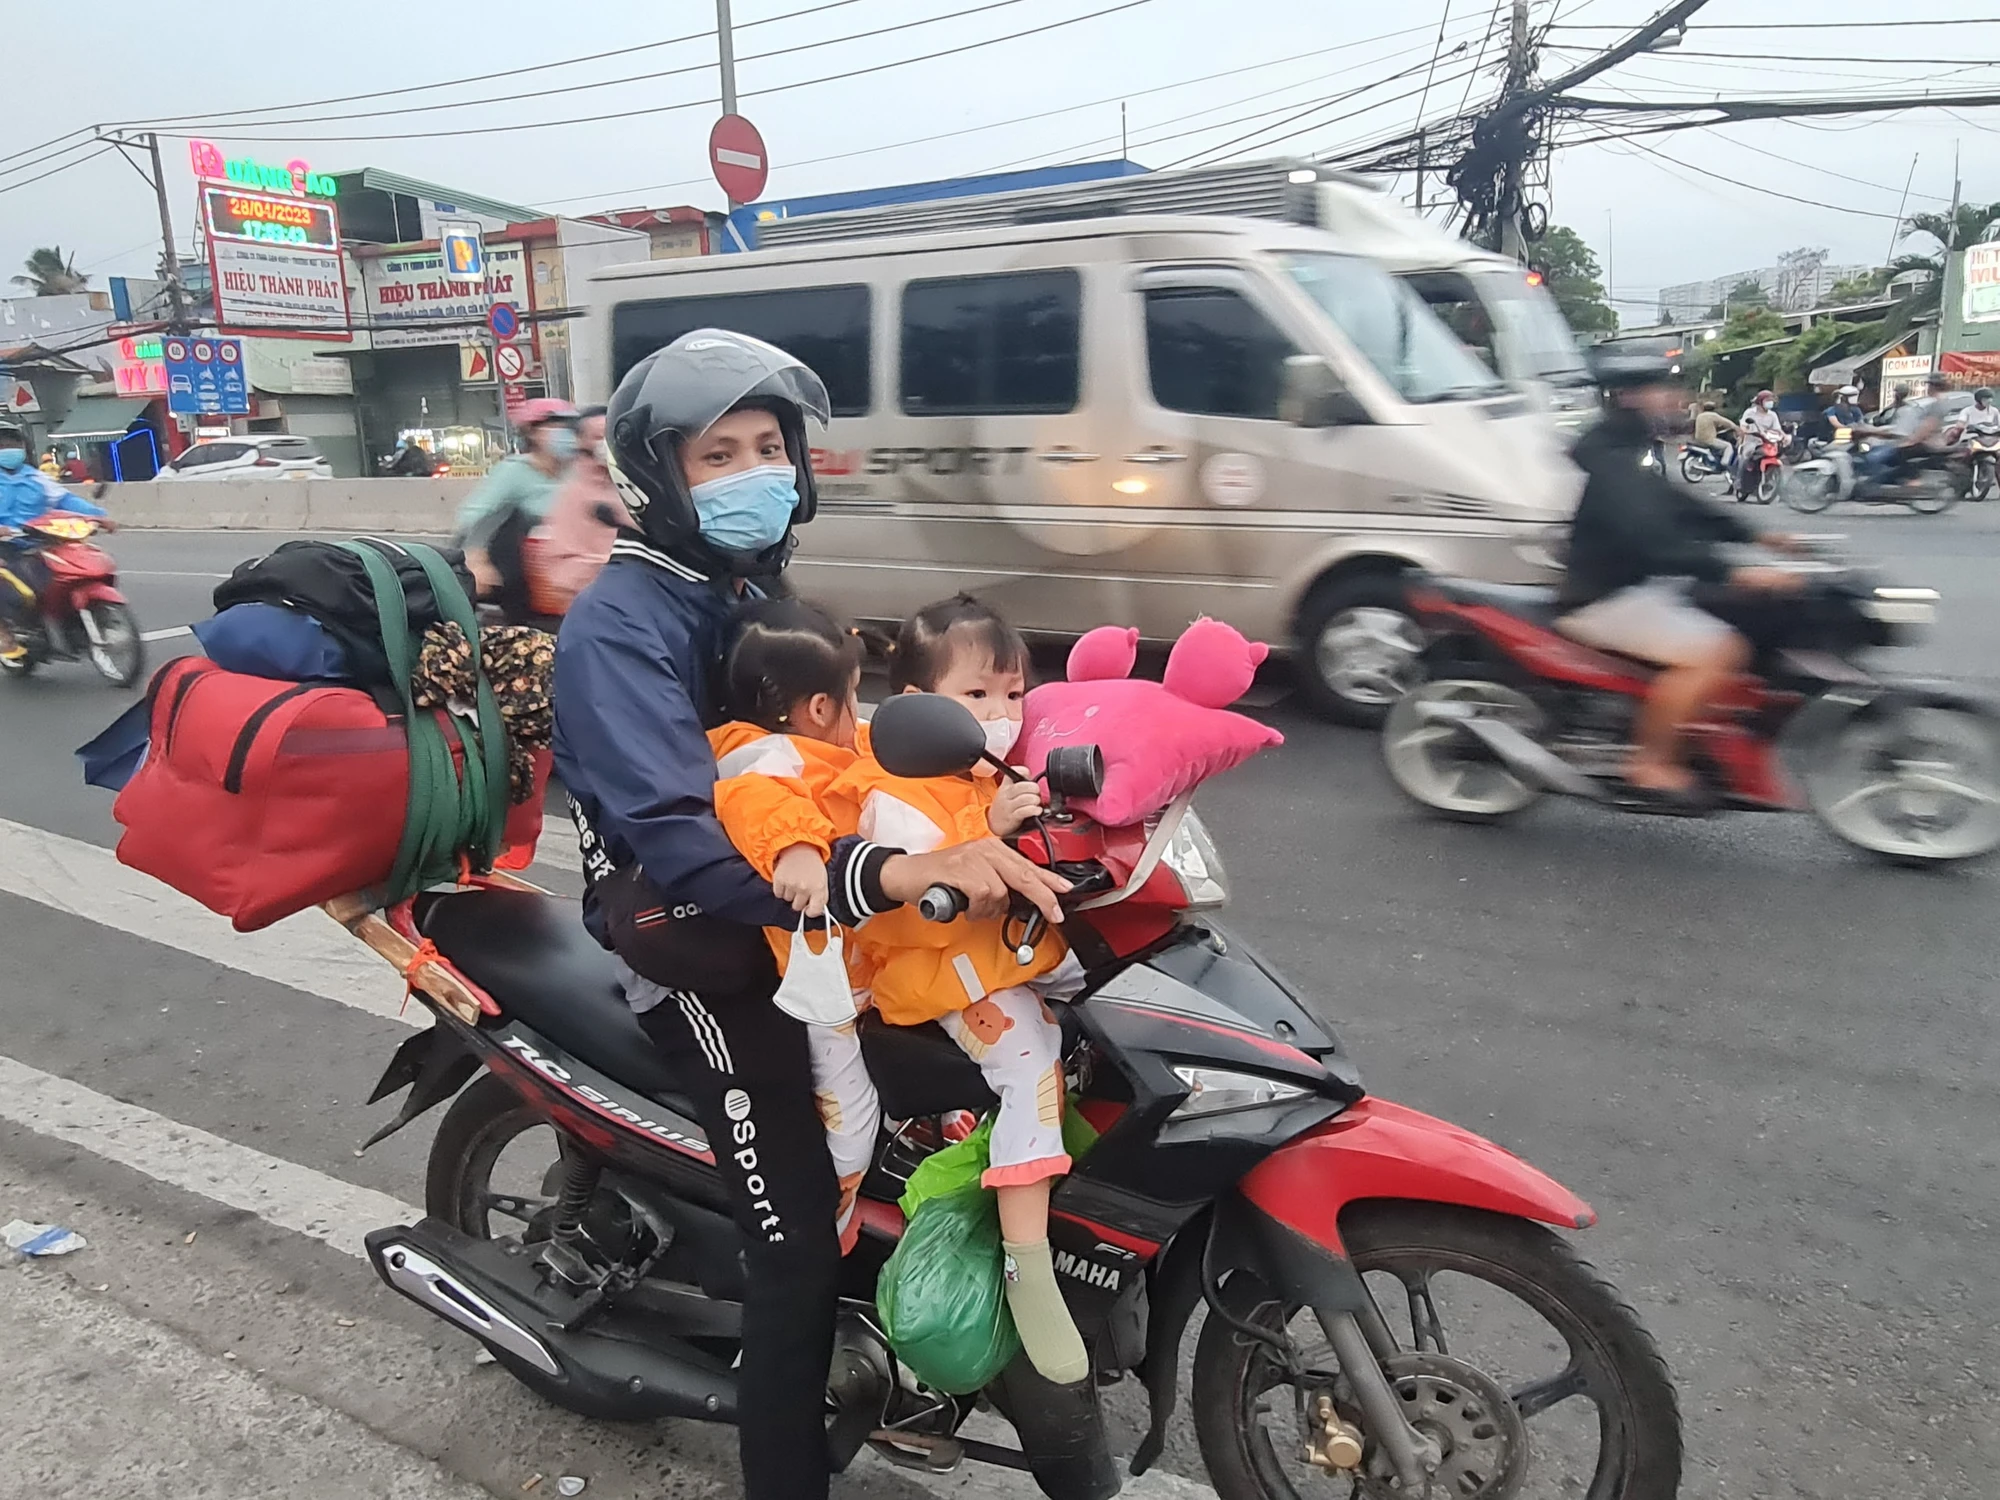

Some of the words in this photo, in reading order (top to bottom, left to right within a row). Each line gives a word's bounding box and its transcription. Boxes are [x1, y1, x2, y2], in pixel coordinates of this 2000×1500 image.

[259, 271, 304, 297] THÀNH
[379, 280, 414, 307] HIỆU
[417, 275, 471, 300] THÀNH
[571, 1084, 711, 1152] SIRIUS
[733, 1119, 785, 1243] Sports
[1049, 1246, 1121, 1291] MAHA
